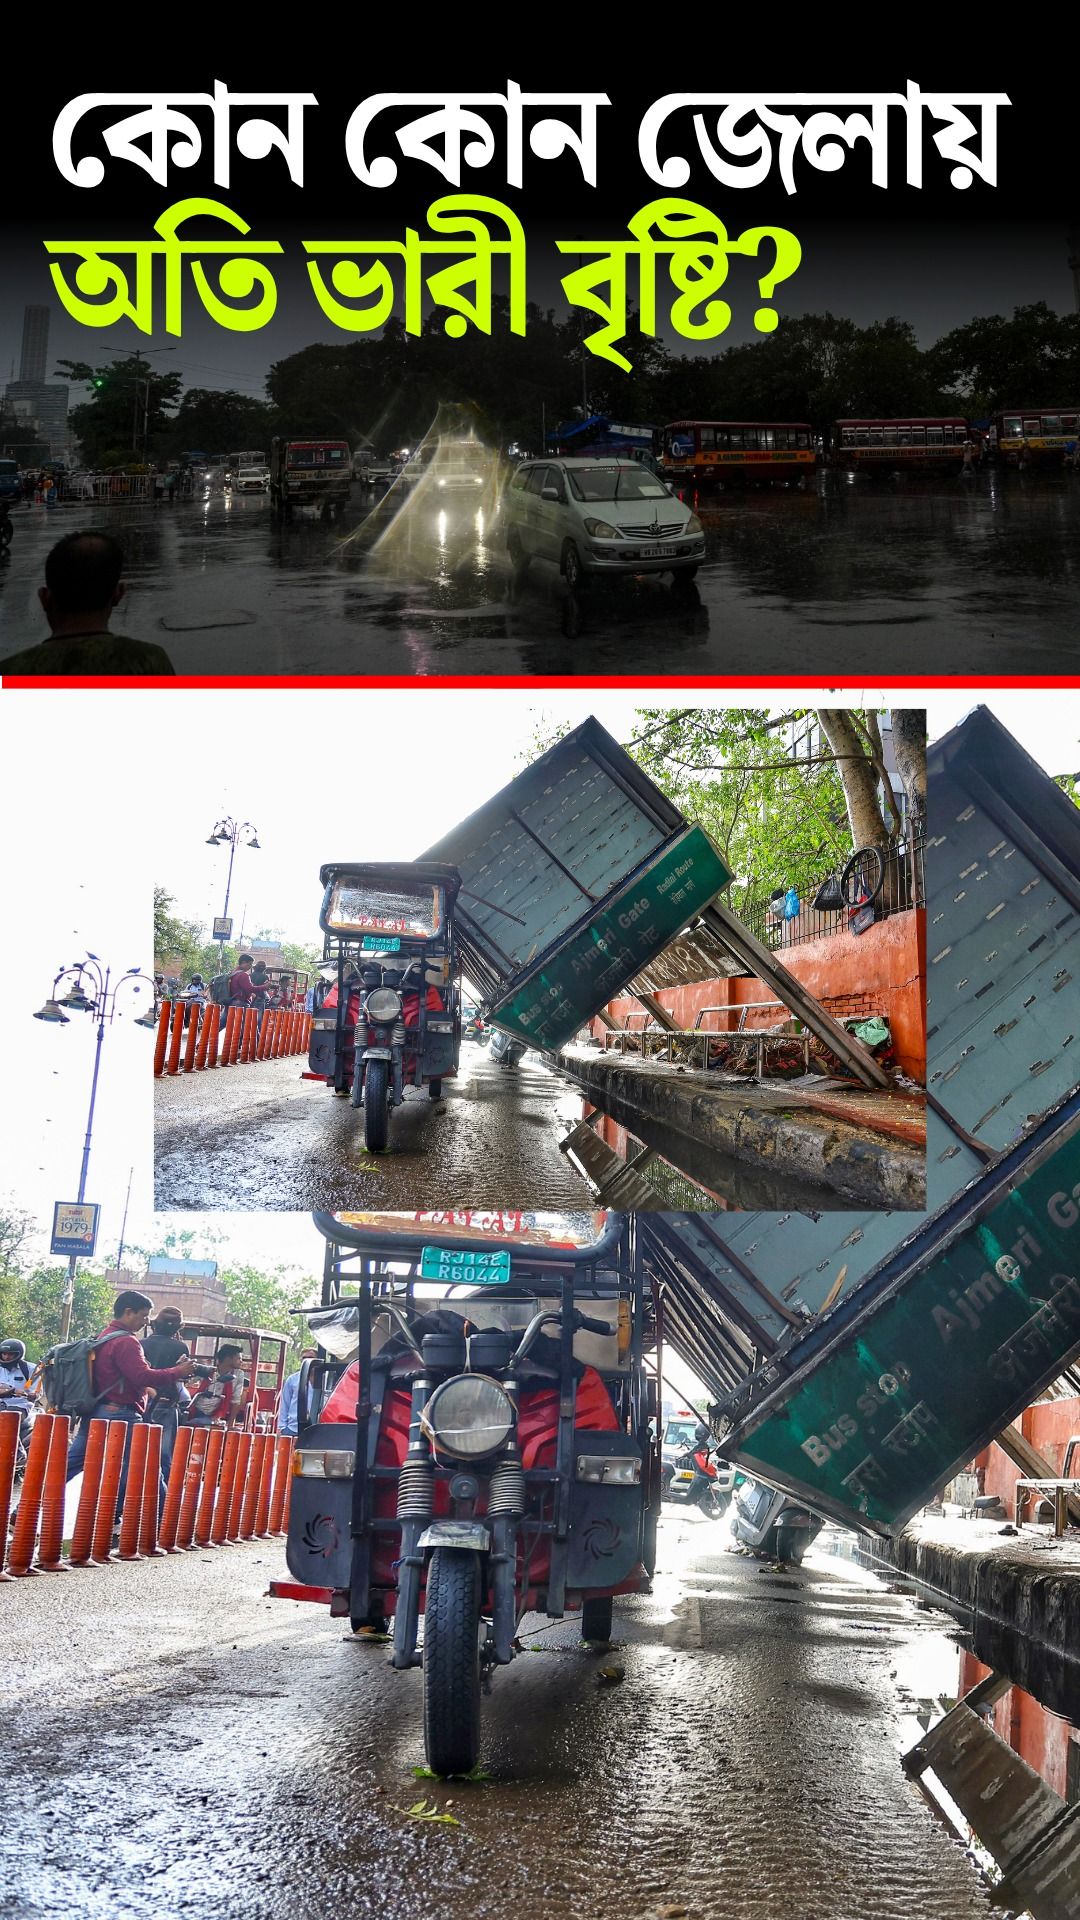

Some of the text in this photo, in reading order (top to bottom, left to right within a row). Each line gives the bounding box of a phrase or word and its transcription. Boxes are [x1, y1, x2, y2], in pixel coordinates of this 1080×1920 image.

[656, 858, 694, 894] Radial Route
[570, 898, 650, 976] Ajmeri Gate
[518, 1003, 542, 1026] Bus
[438, 1264, 500, 1282] R6044
[439, 1250, 502, 1267] RJ14E
[931, 1225, 1043, 1344] Ajmeri
[800, 1361, 913, 1468] Bus stop
